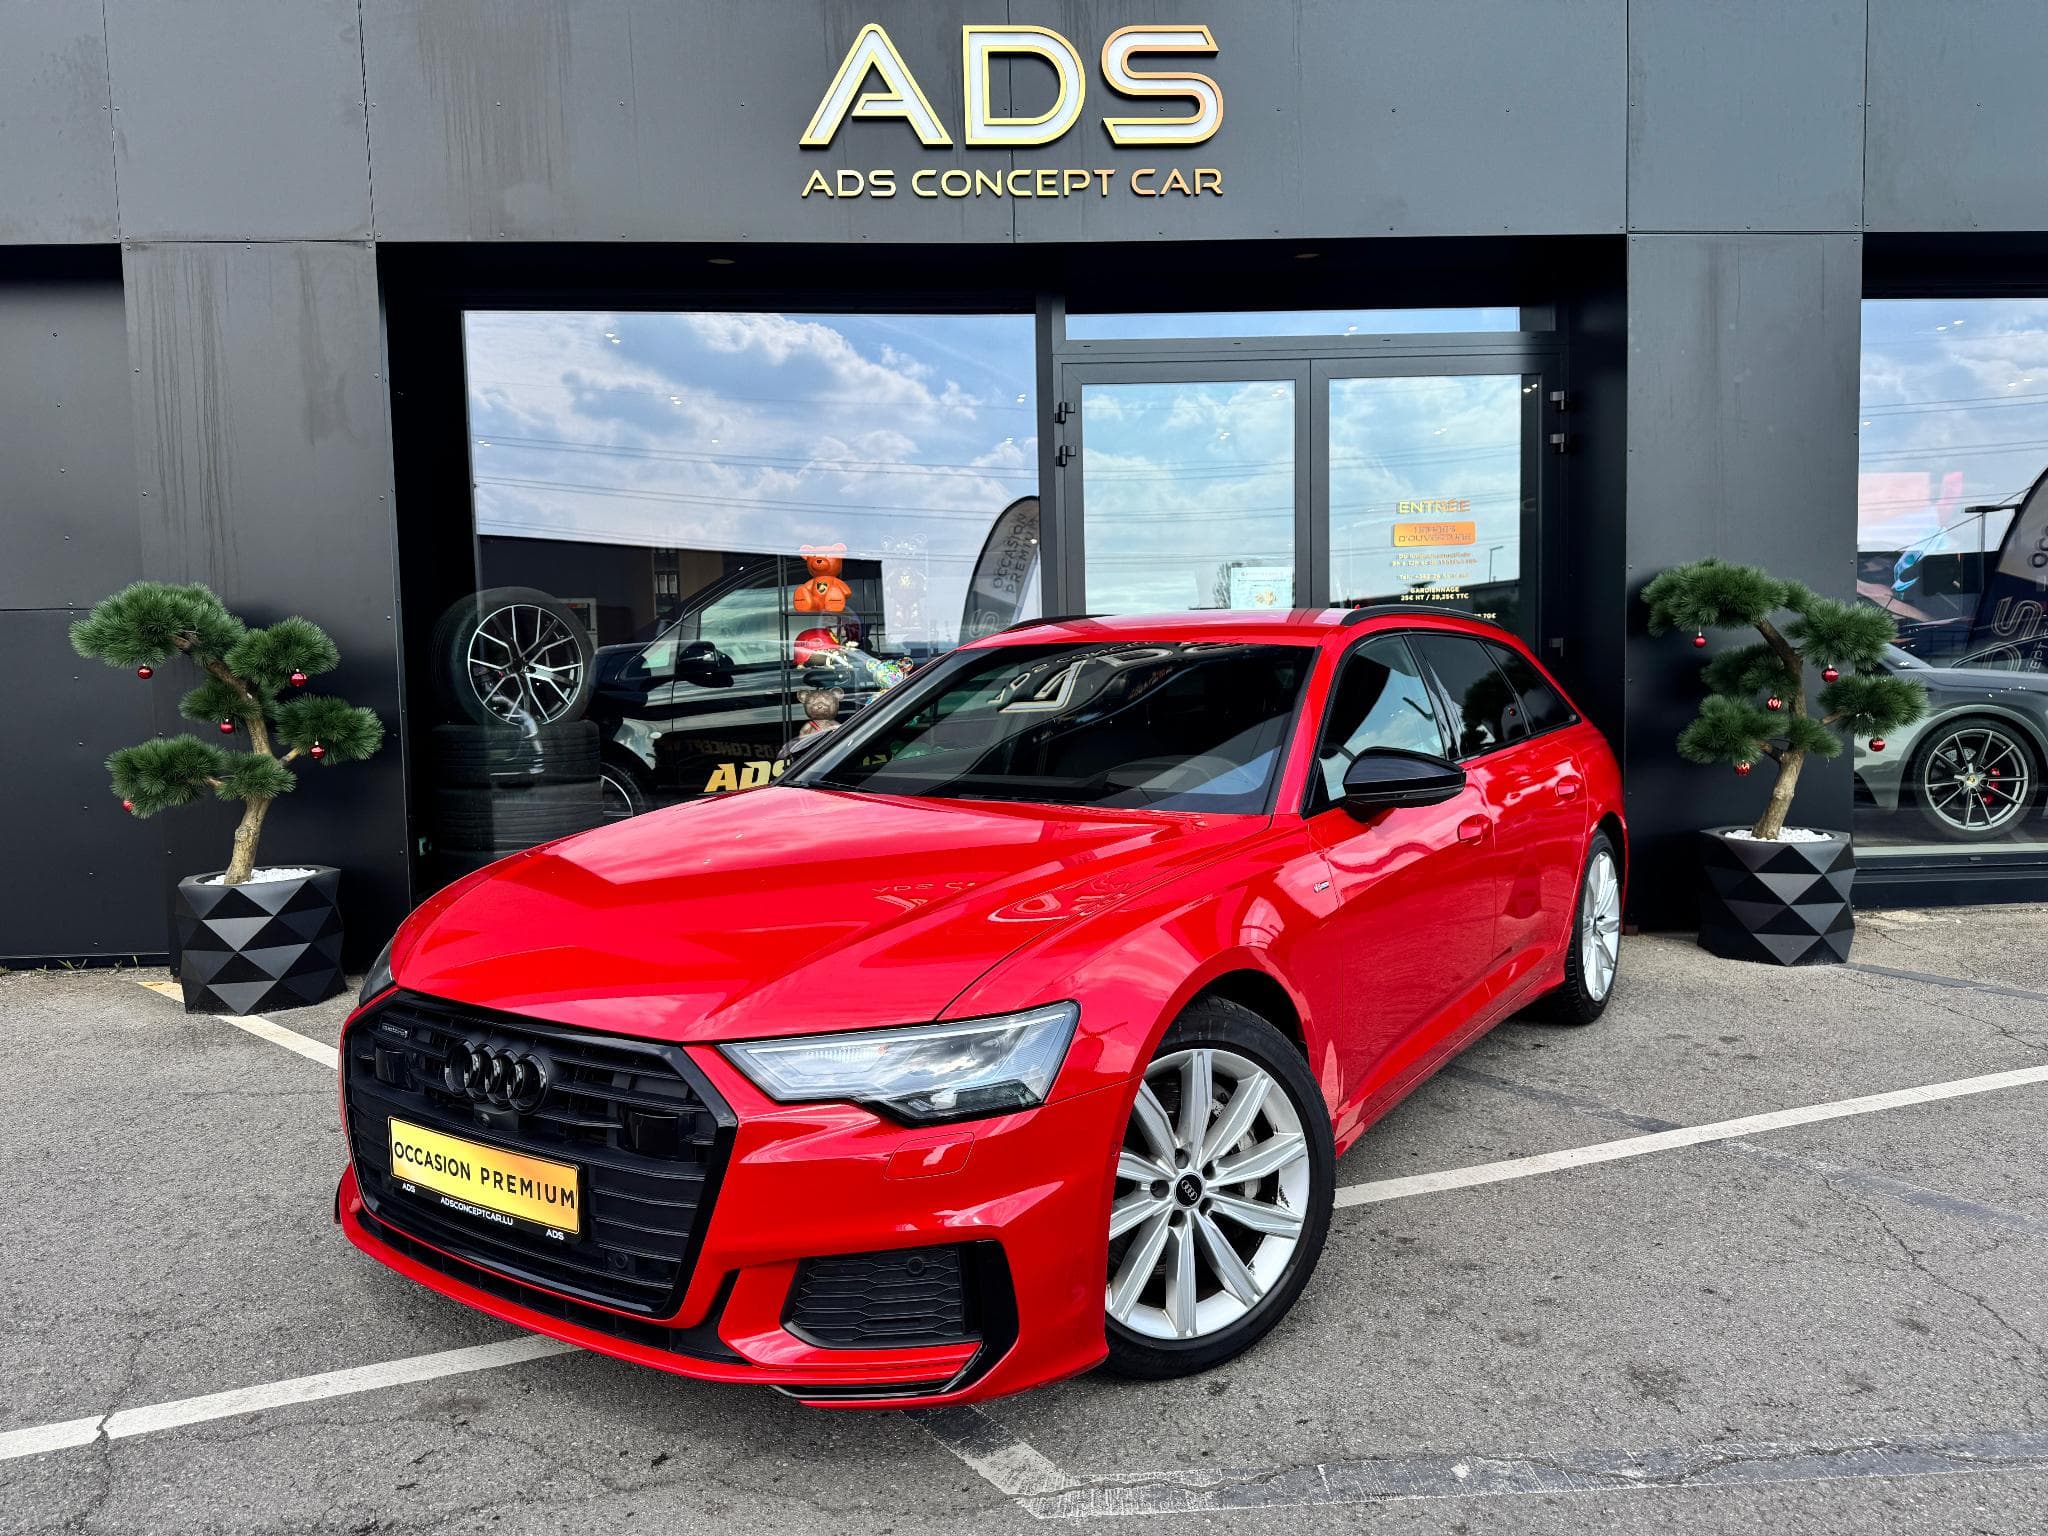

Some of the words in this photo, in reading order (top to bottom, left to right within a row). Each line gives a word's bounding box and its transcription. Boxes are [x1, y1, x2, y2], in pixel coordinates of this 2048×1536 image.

[799, 23, 1224, 146] ADS
[802, 169, 897, 198] ADS
[911, 169, 1116, 197] CONCEPT
[1130, 168, 1224, 196] CAR
[992, 512, 1028, 590] OCCASION
[1005, 518, 1039, 595] PREMIUM
[394, 1141, 471, 1181] OCCASION
[480, 1167, 575, 1209] PREMIUM
[402, 1182, 416, 1194] ADS
[546, 1228, 565, 1241] ADS
